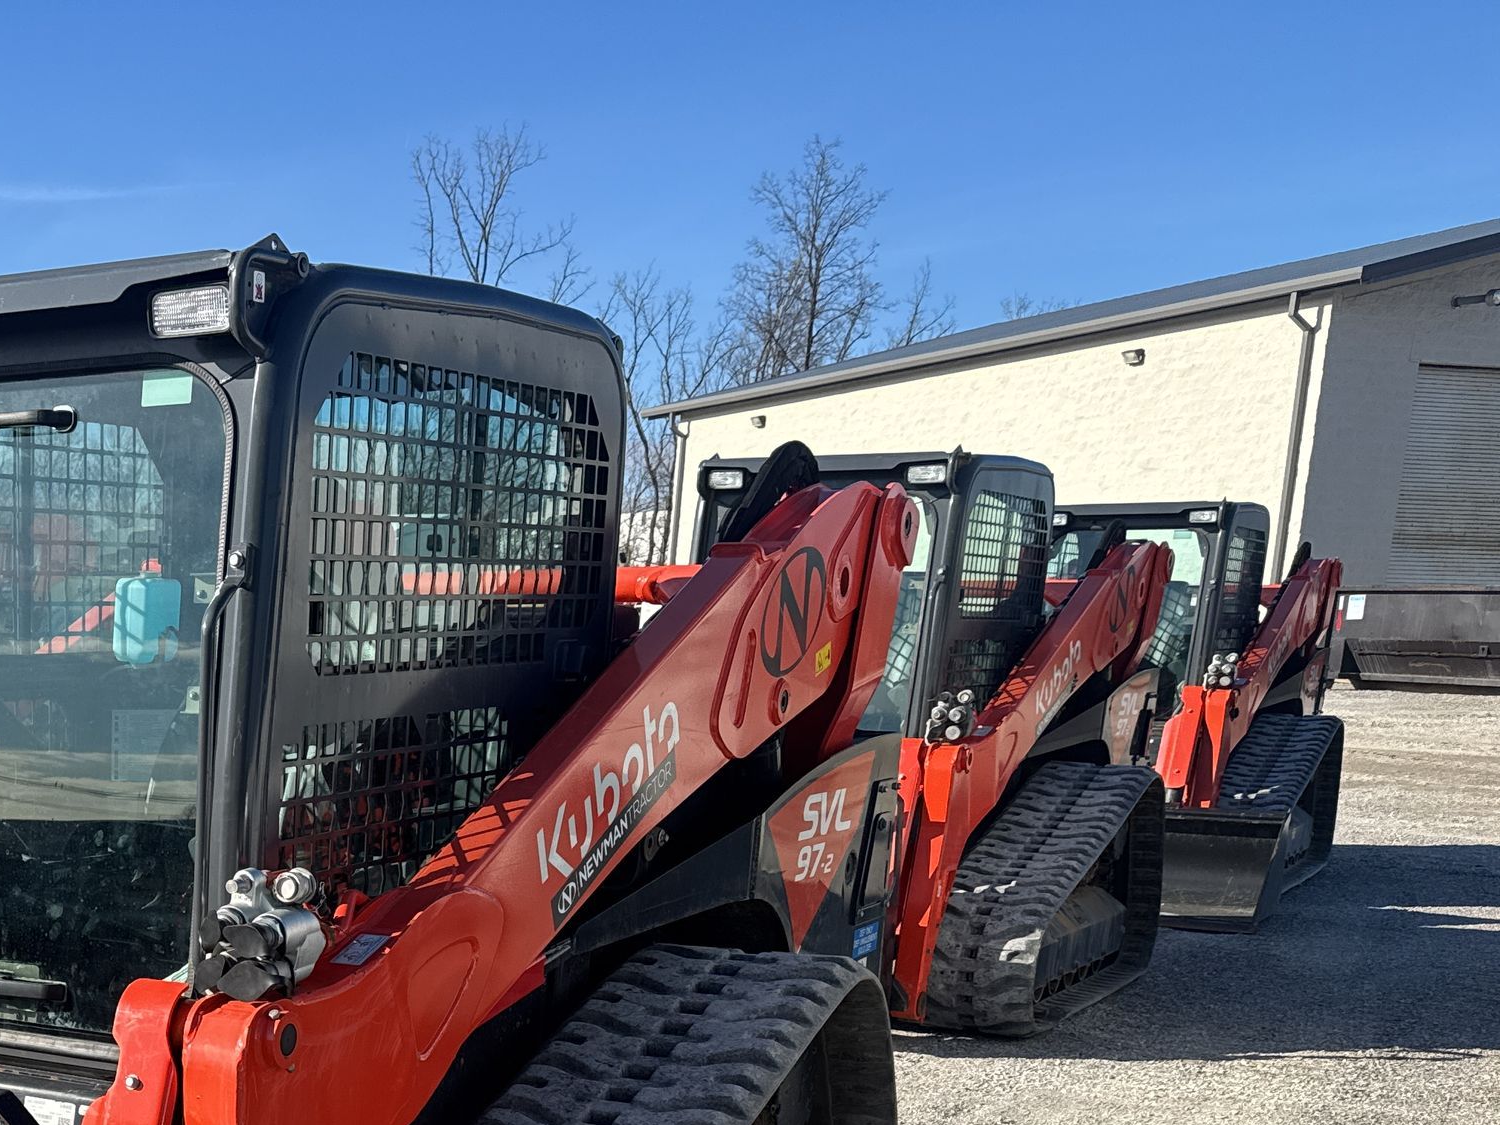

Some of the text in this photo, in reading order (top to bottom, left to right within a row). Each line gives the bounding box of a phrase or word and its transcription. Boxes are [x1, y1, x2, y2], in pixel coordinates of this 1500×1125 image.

[1035, 639, 1082, 714] Kubota
[536, 701, 680, 884] Kubota
[798, 788, 851, 841] SVL
